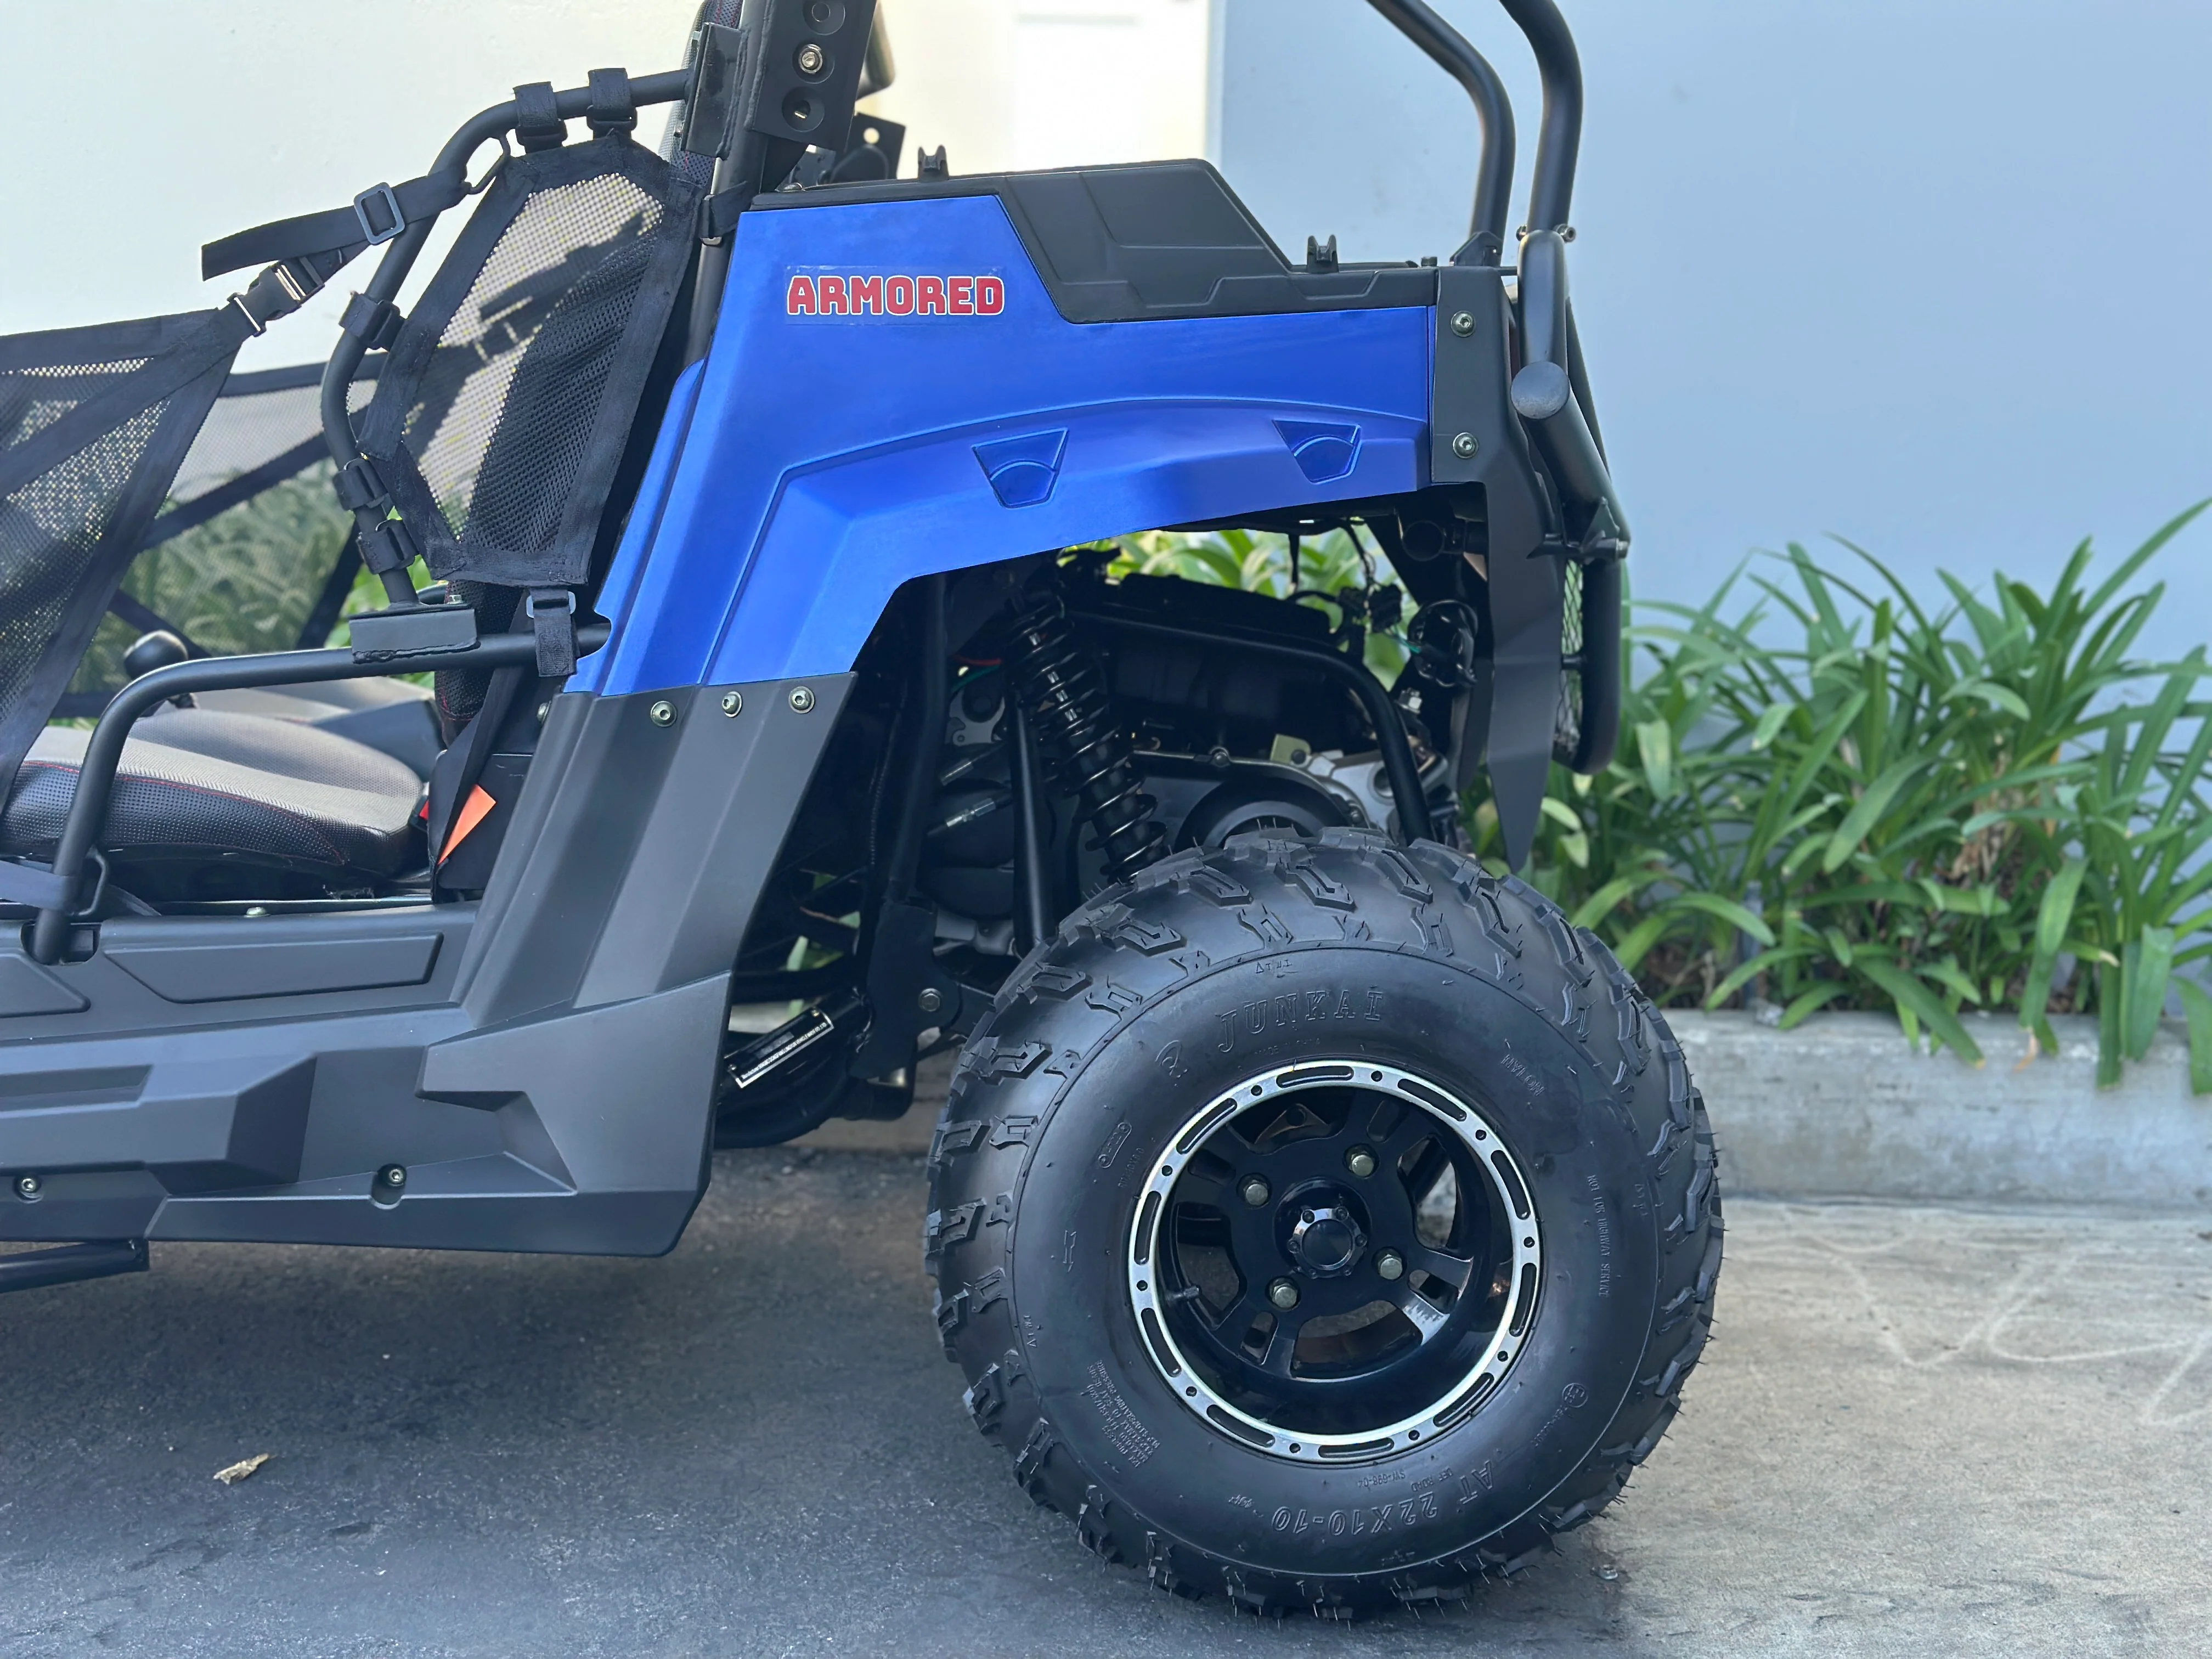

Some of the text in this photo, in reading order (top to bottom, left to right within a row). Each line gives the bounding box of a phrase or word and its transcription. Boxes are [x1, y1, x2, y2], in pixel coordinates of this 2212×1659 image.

[787, 275, 1005, 315] ARMORED
[1218, 989, 1384, 1053] JUNKAI
[1500, 1054, 1545, 1097] NYLON
[1587, 1175, 1611, 1298] NOT FOR HIGHWAY SERVICE
[1410, 1474, 1434, 1492] ROAD
[1272, 1491, 1438, 1536] 22X10-10
